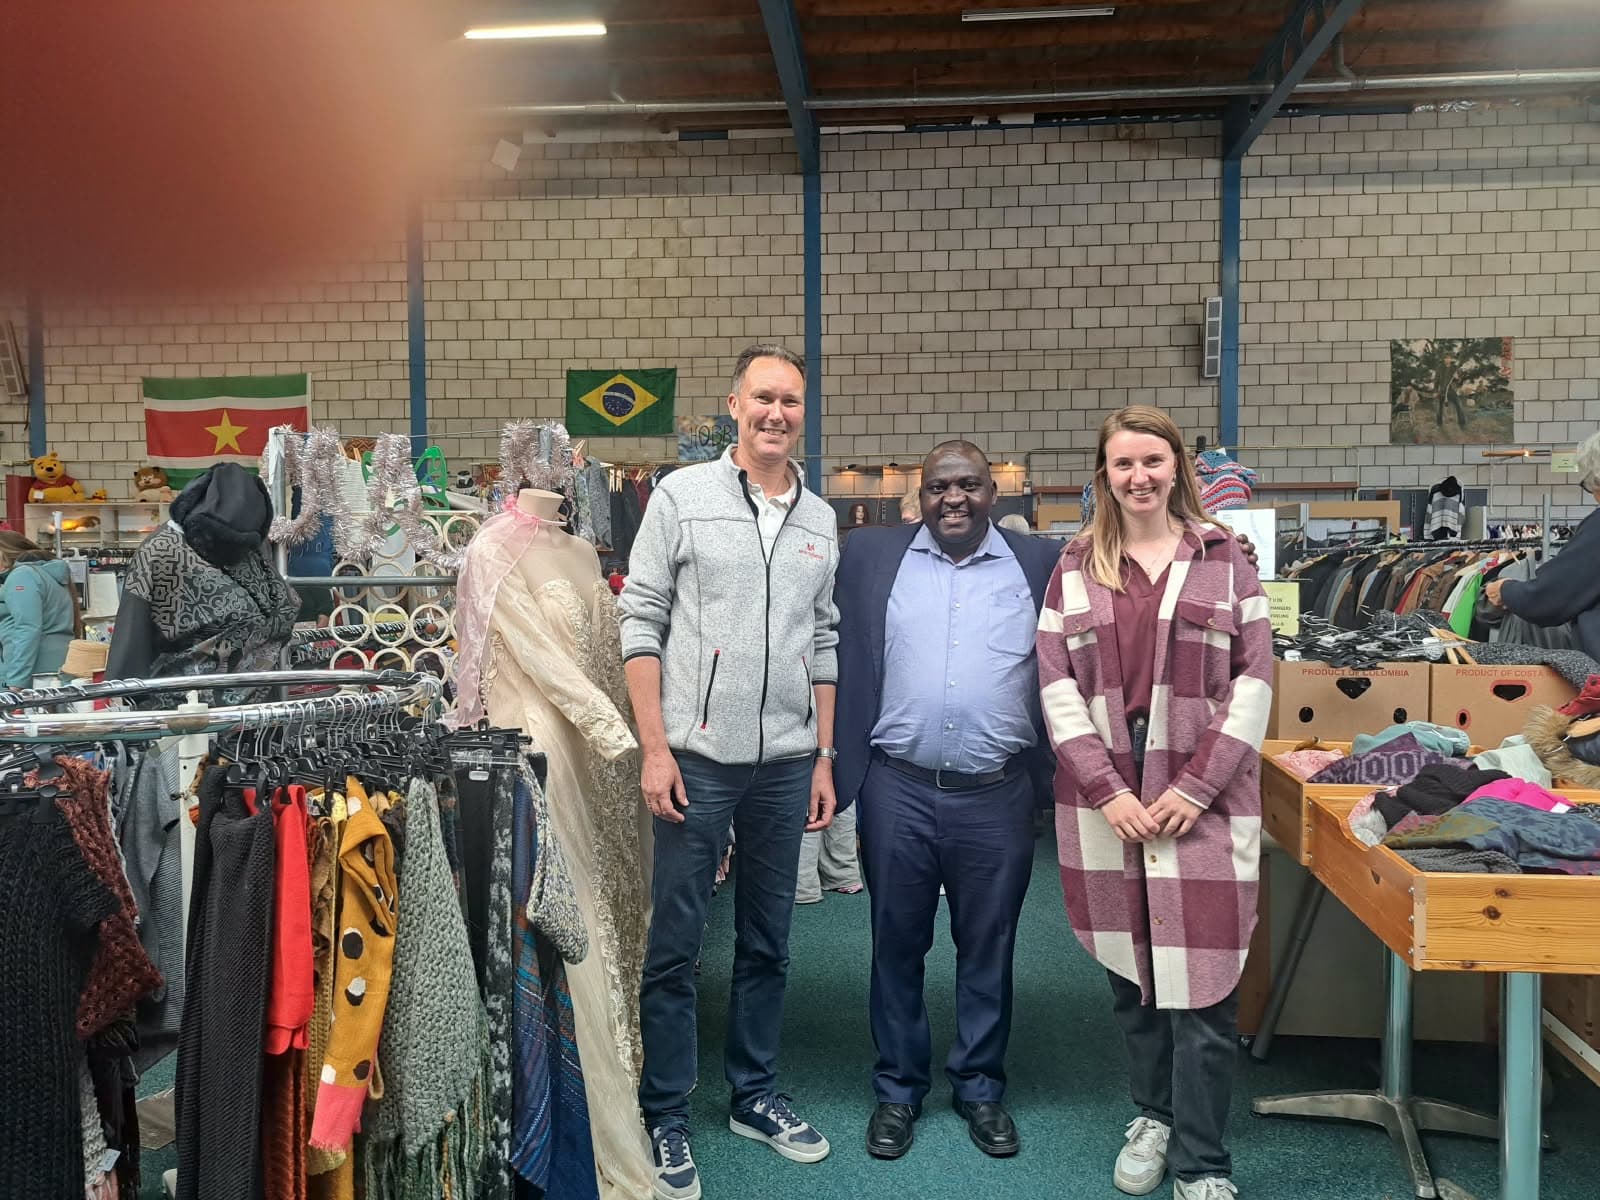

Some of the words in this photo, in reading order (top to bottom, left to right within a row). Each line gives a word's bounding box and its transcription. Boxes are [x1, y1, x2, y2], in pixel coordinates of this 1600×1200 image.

[690, 424, 733, 448] HOBB
[1302, 668, 1345, 676] PRODUCT
[1348, 669, 1360, 677] OF
[1362, 669, 1409, 677] COLOMBIA
[1456, 668, 1498, 677] PRODUCT
[1501, 669, 1512, 677] OF
[1514, 669, 1543, 677] COSTA
